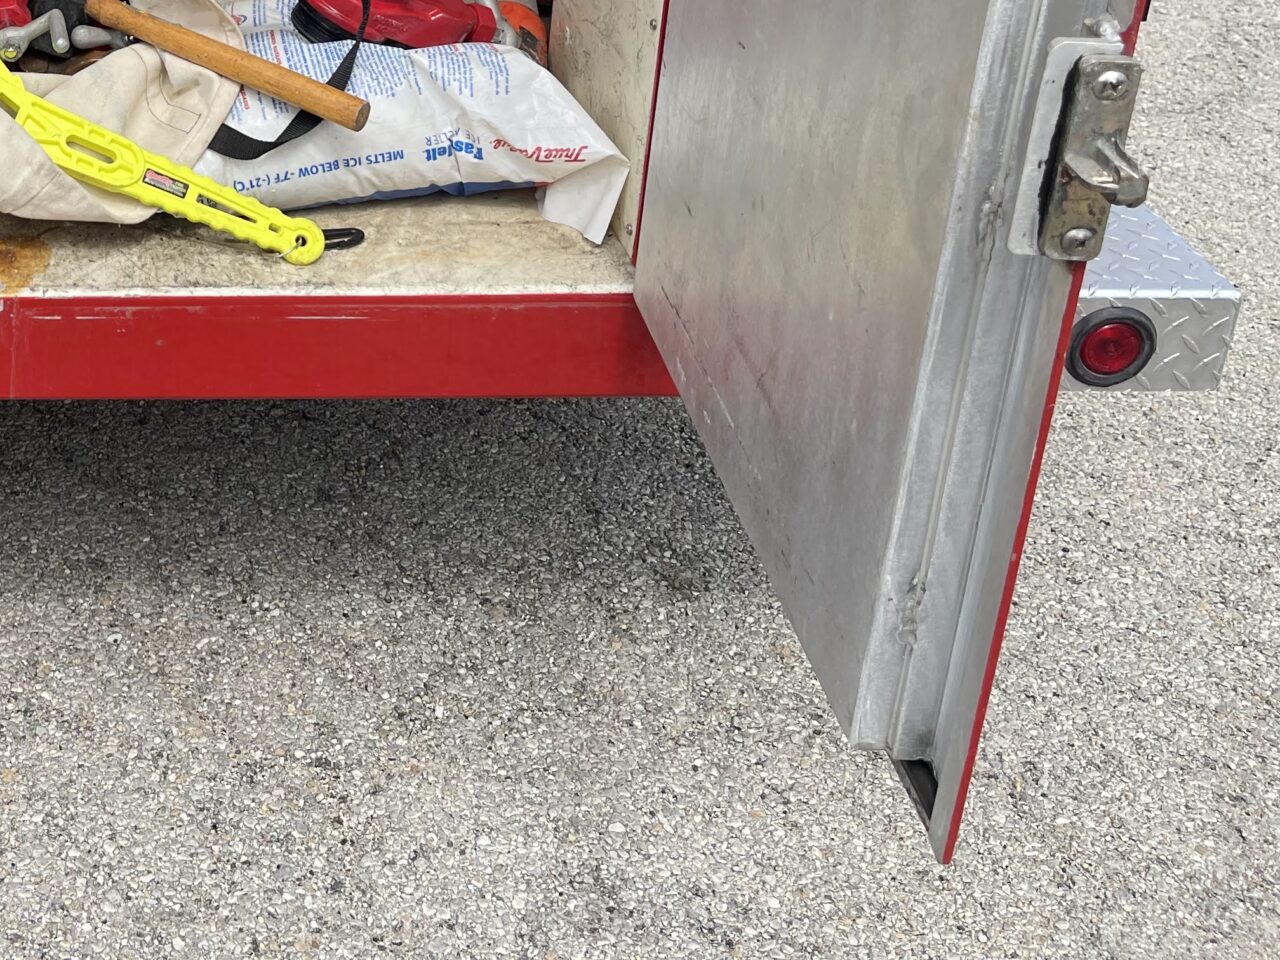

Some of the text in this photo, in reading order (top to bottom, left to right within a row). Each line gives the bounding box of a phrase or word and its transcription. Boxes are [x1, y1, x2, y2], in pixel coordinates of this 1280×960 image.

[342, 158, 362, 167] ICE
[365, 149, 404, 165] MELTS
[298, 159, 340, 178] BELOW
